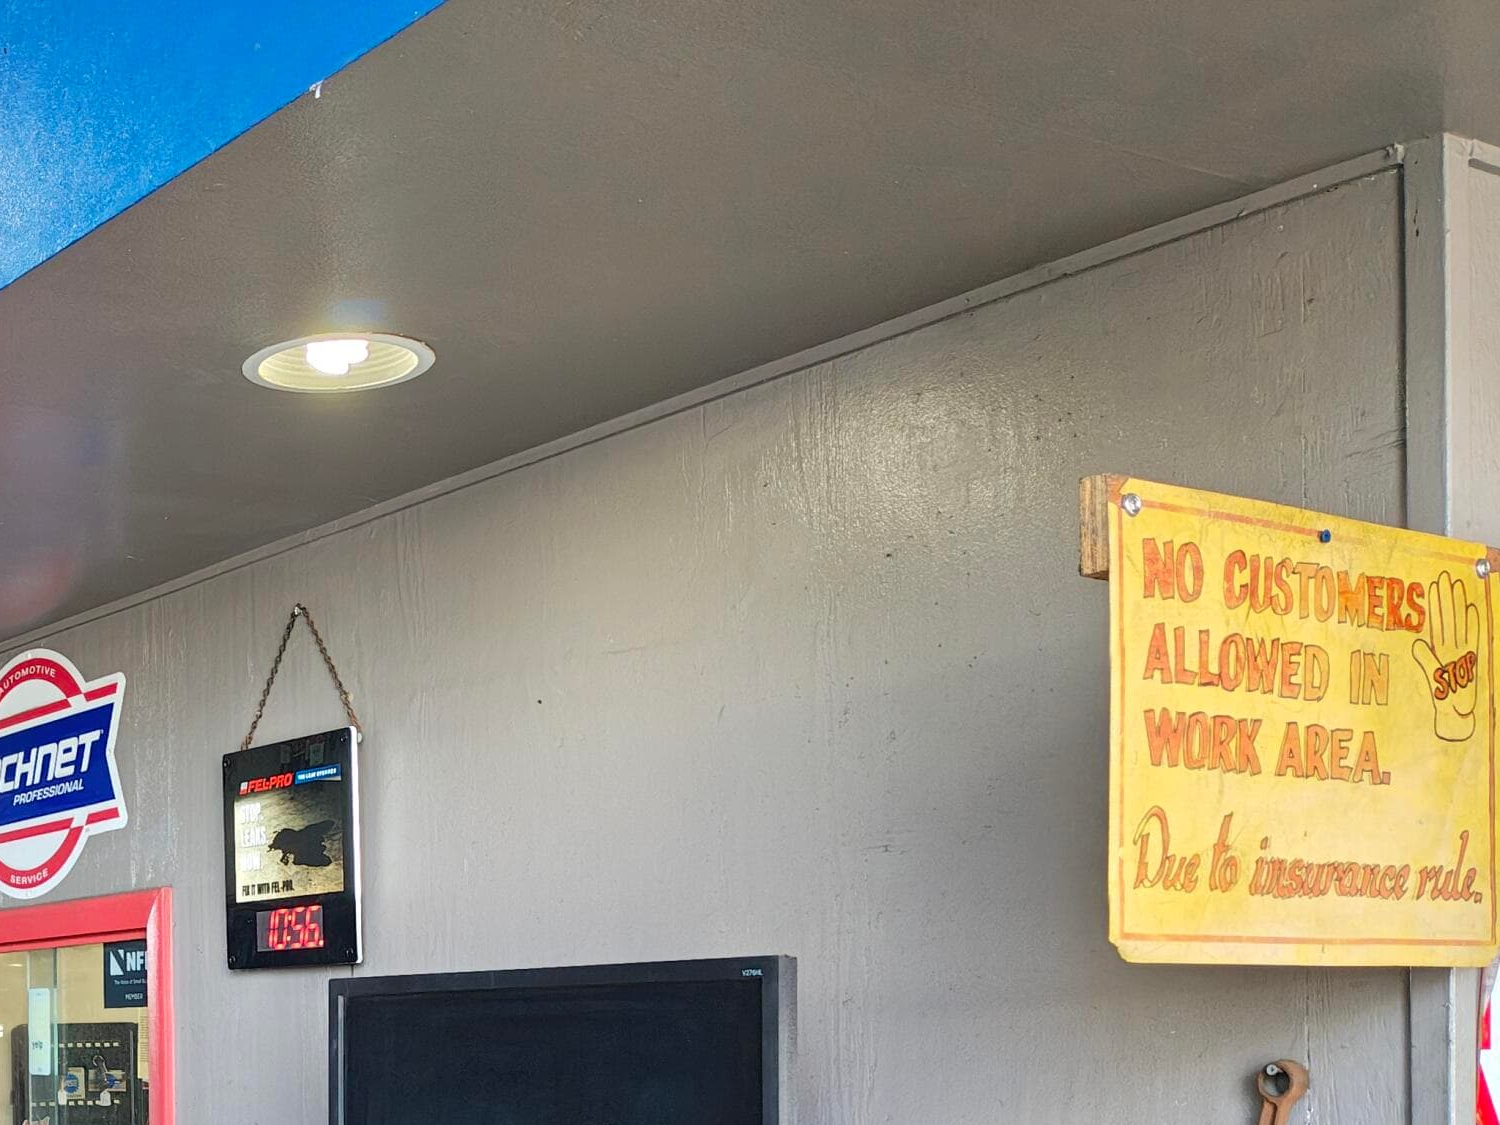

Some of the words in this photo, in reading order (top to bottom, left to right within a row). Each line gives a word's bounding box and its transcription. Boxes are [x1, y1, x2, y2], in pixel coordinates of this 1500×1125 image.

[1142, 537, 1205, 603] NO
[1225, 549, 1427, 634] CUSTOMERS
[1143, 622, 1330, 703] ALLOWED
[1350, 649, 1390, 706] IN
[1433, 650, 1477, 701] STOP
[1143, 707, 1263, 777] WORK
[1275, 721, 1392, 786] AREA.
[13, 778, 85, 807] PROFESSIONAL
[247, 772, 294, 794] FEL-PRO
[10, 869, 49, 885] SERVICE
[1133, 804, 1201, 891] Due
[1208, 811, 1241, 893] to
[1248, 836, 1411, 901] insurance
[1416, 829, 1484, 904] rule.
[126, 950, 149, 972] NFI
